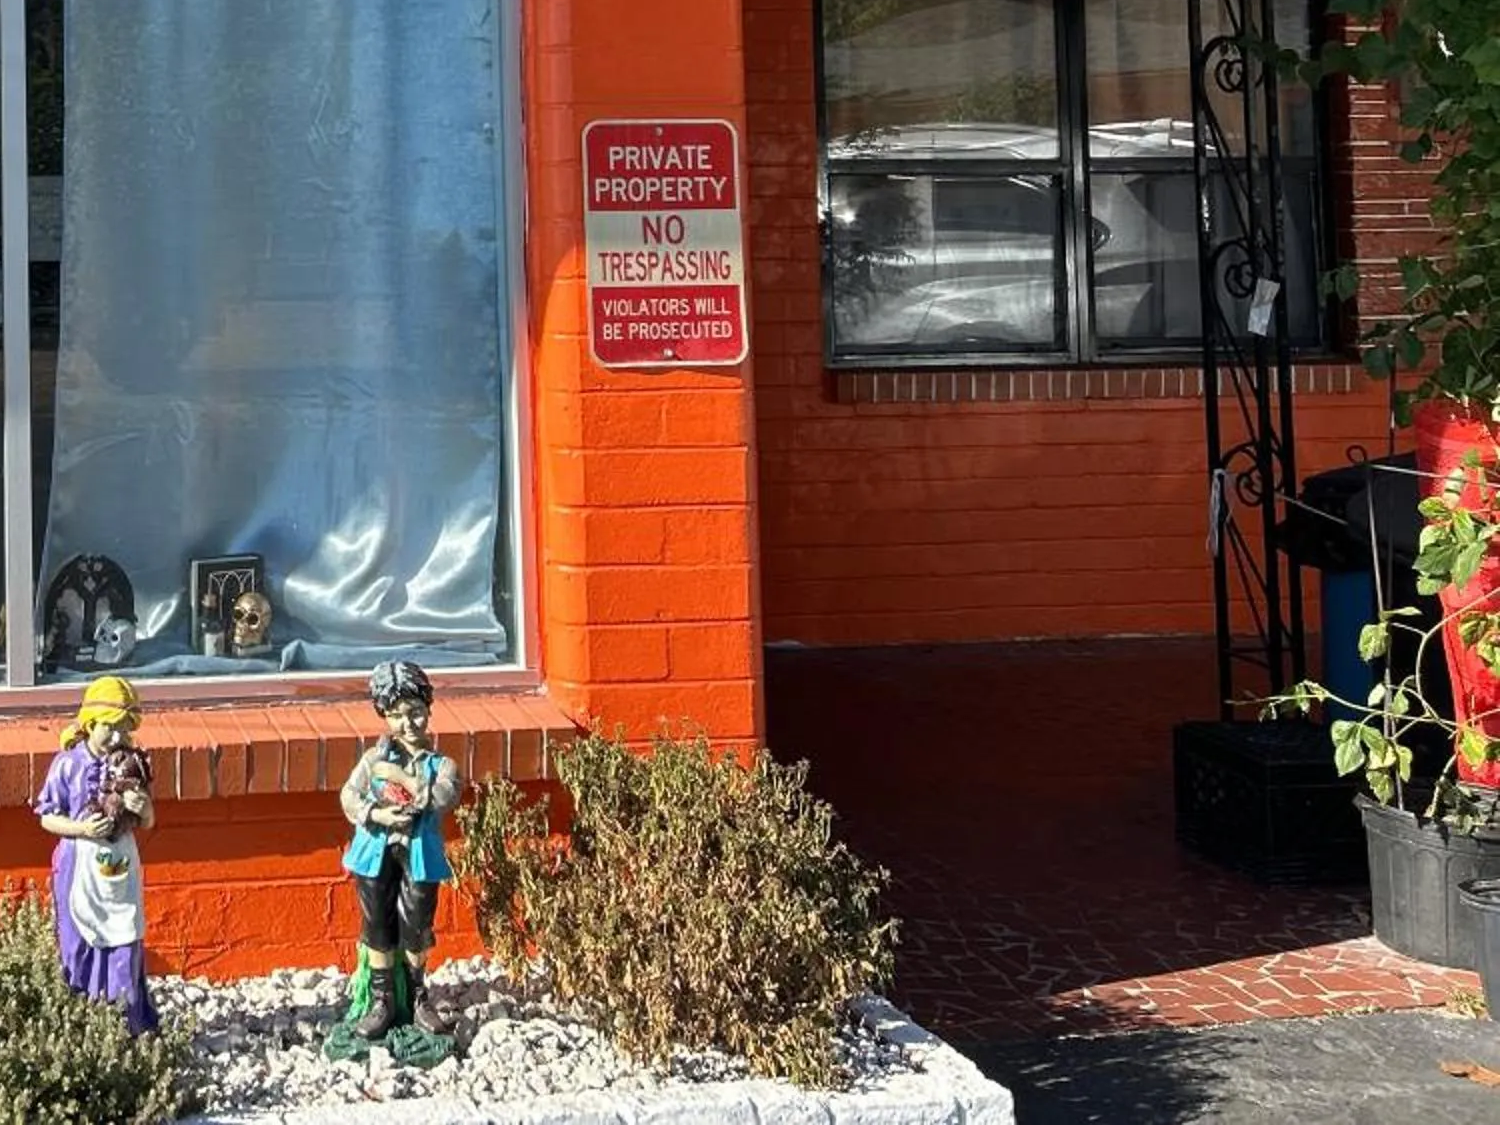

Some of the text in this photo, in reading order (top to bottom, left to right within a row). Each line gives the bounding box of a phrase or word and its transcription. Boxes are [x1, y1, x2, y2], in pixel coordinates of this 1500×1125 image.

[609, 145, 712, 171] PRIVATE
[595, 177, 727, 202] PROPERTY
[641, 215, 685, 245] NO
[598, 251, 731, 282] TRESPASSING
[602, 297, 731, 317] VIOLATORS WILL
[602, 321, 733, 340] BE PROSECUTED
